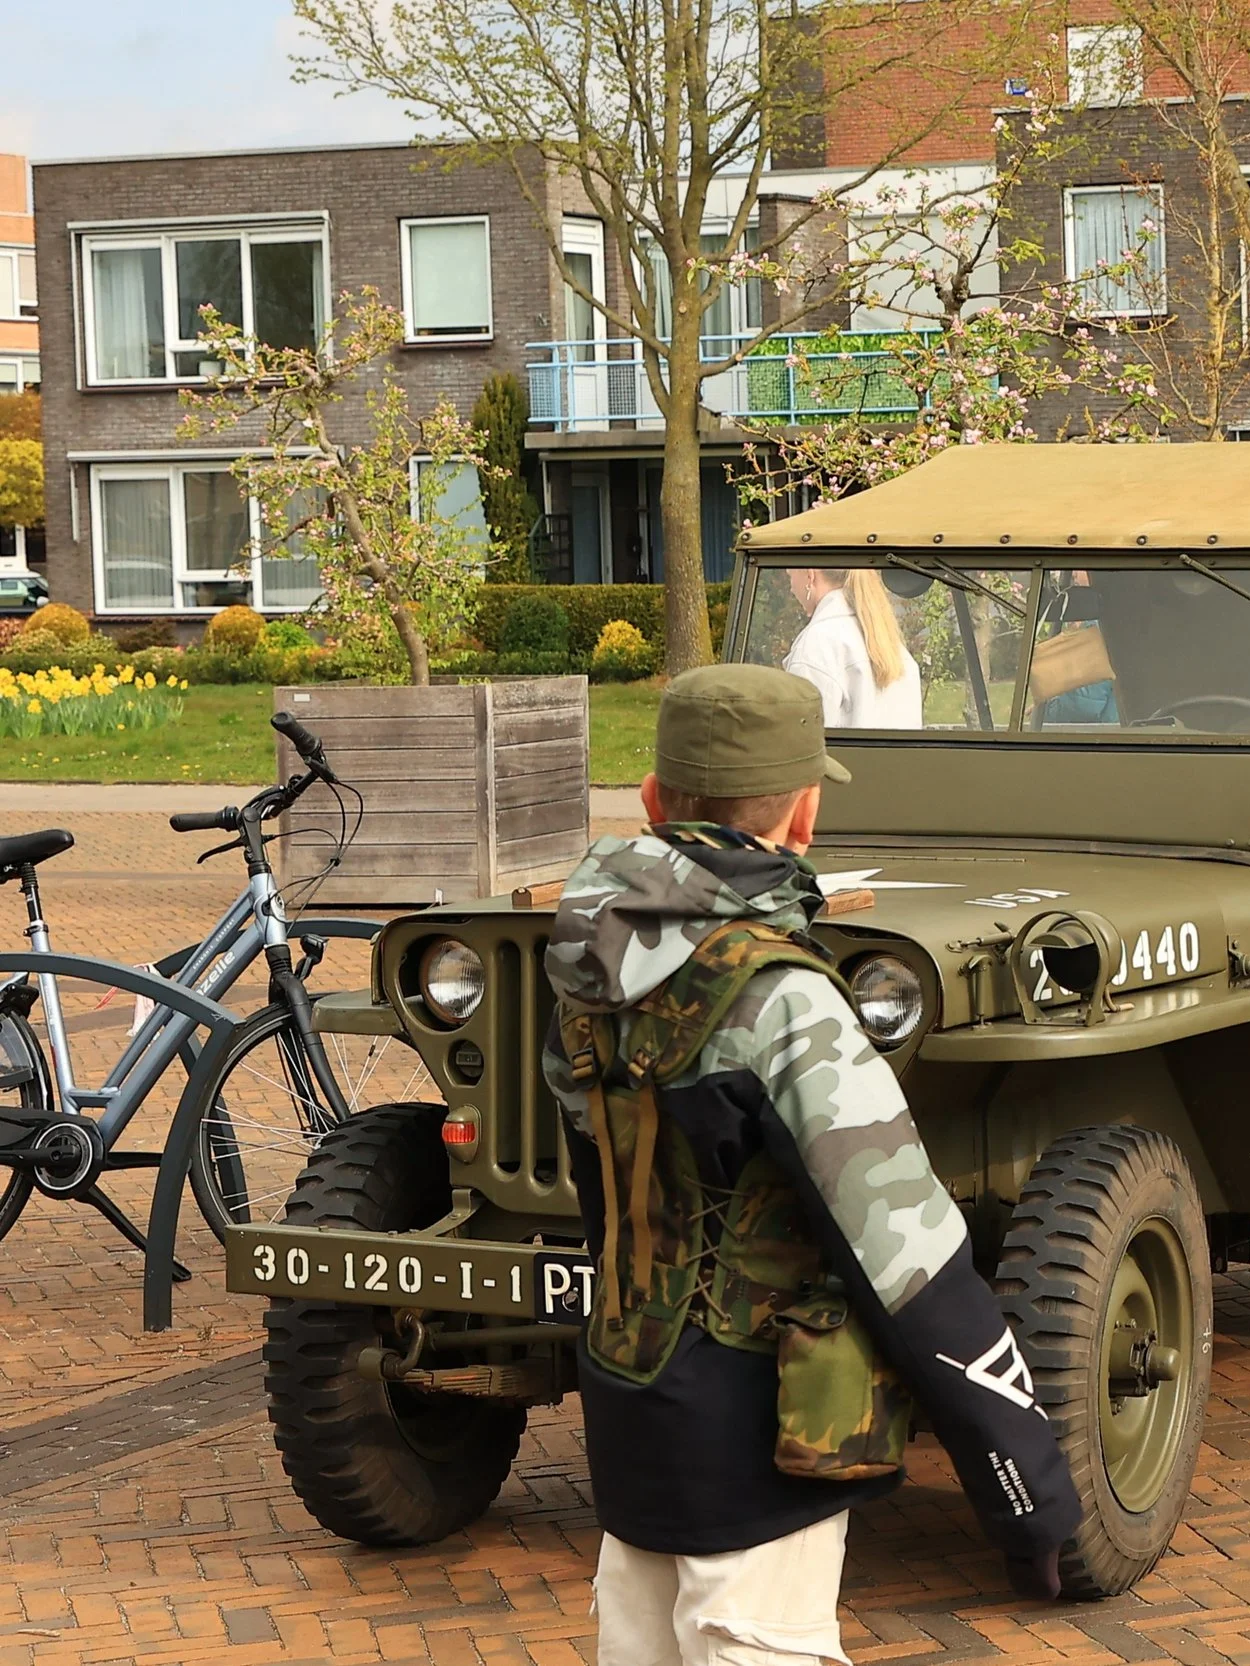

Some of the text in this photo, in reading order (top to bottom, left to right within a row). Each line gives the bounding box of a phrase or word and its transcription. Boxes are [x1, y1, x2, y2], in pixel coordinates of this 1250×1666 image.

[964, 888, 1070, 909] USA
[988, 1451, 1023, 1516] NO MATTER THE
[1004, 1458, 1034, 1512] CONDITIONS
